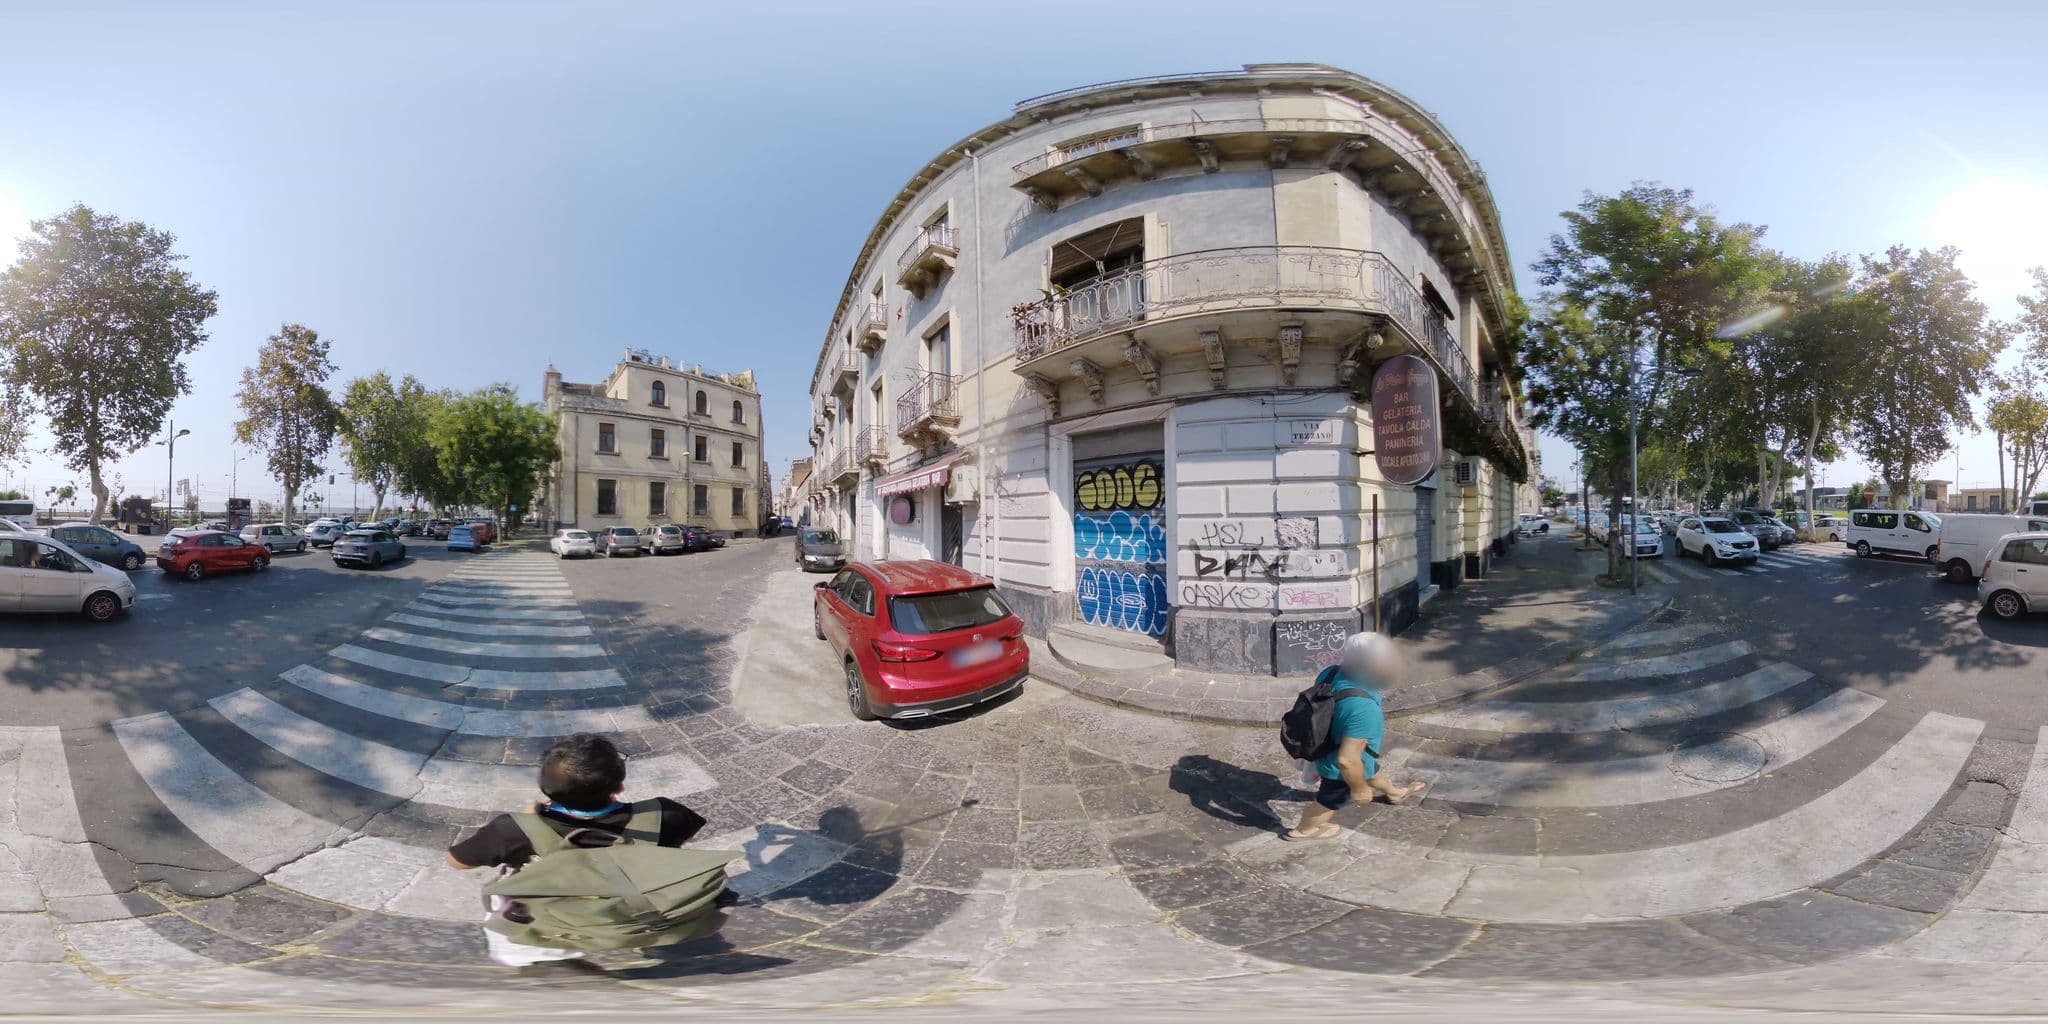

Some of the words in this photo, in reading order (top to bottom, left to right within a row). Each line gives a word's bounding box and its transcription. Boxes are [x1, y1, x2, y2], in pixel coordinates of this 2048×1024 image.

[1394, 391, 1409, 404] BAR
[1383, 404, 1423, 420] GELATERIA
[1378, 423, 1403, 437] TAVOLA
[1406, 419, 1431, 432] CALDA
[1294, 432, 1331, 440] TEZZANO
[1385, 435, 1424, 449] PANINERIA
